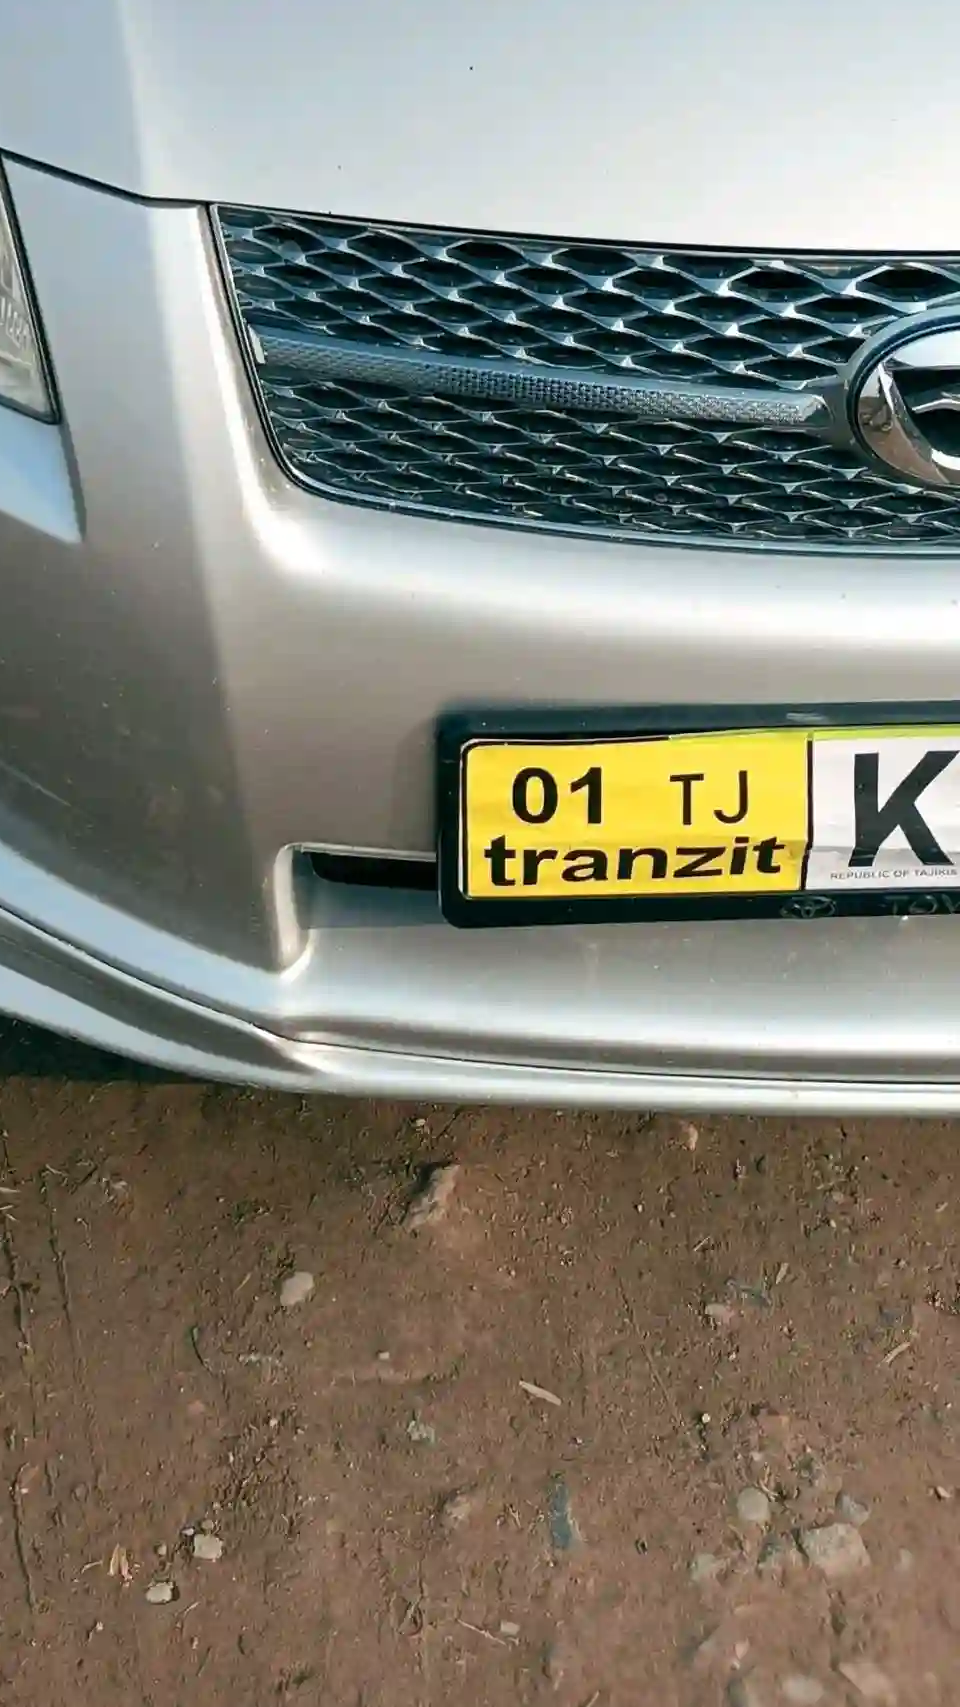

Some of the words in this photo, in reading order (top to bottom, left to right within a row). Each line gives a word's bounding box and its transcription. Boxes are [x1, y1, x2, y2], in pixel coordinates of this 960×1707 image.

[511, 766, 603, 825] 01
[669, 770, 749, 826] TJ
[847, 750, 960, 868] K
[484, 835, 786, 888] tranzit
[830, 869, 889, 880] REPUBLIC
[893, 869, 909, 878] OF
